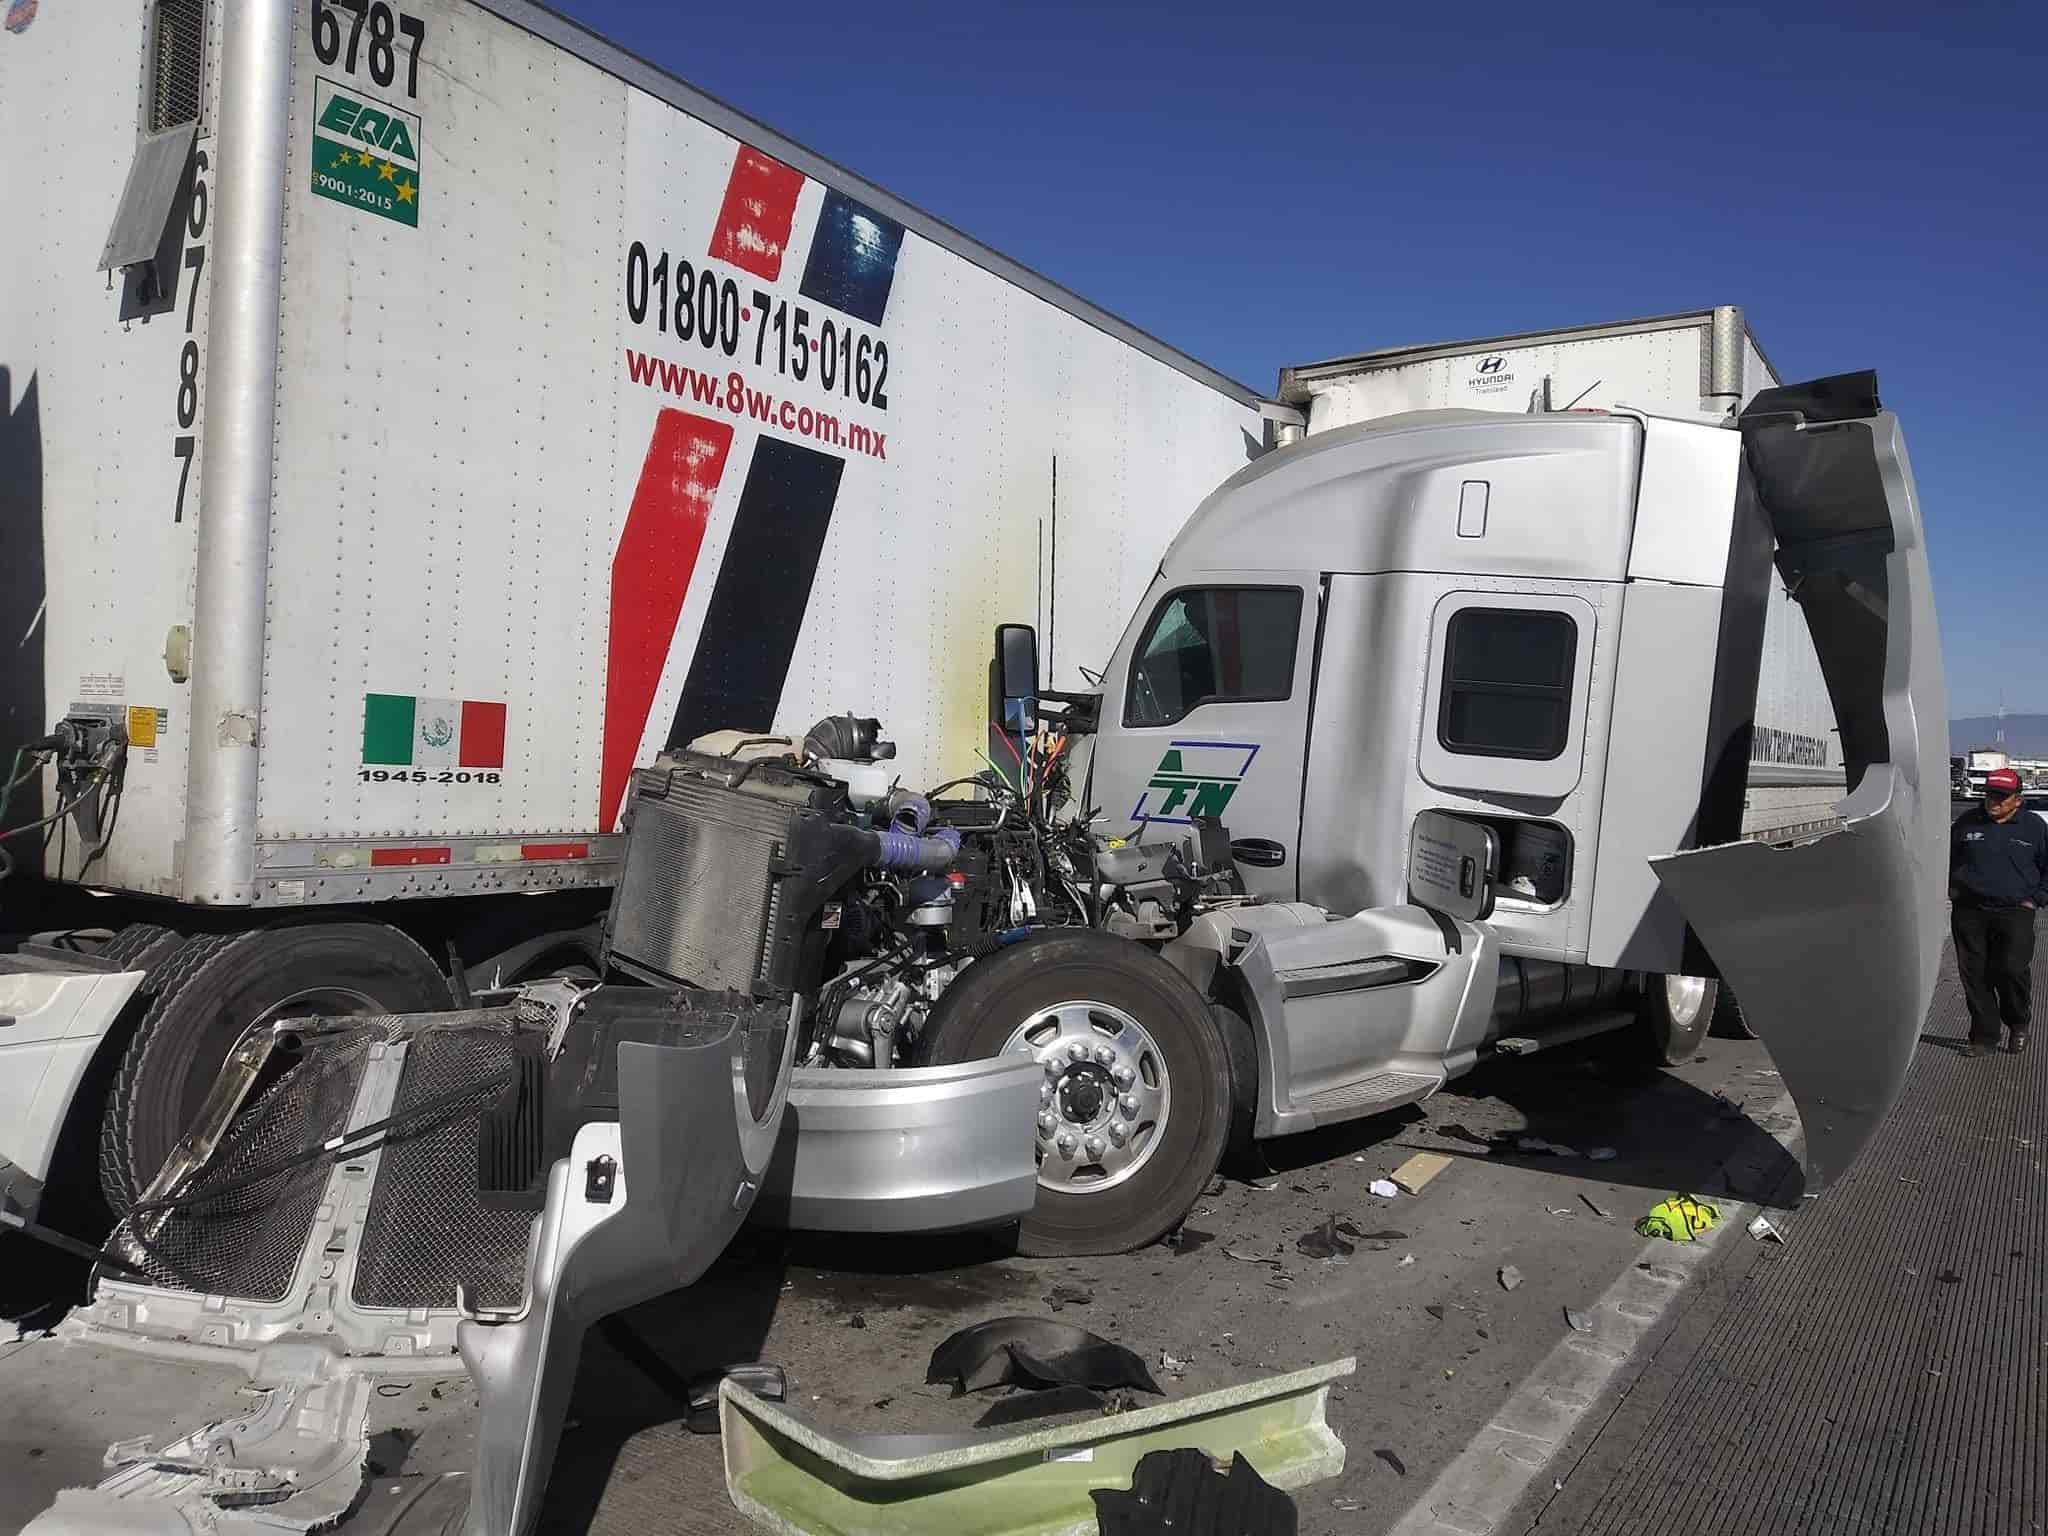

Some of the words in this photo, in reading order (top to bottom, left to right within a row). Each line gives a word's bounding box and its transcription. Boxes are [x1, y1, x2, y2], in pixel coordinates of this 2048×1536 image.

[312, 0, 425, 98] 6787
[319, 174, 392, 209] 9001:2015
[1468, 373, 1514, 386] HYUNDAI
[626, 348, 887, 459] www.8w.com.mx
[357, 770, 500, 784] 1945-2018
